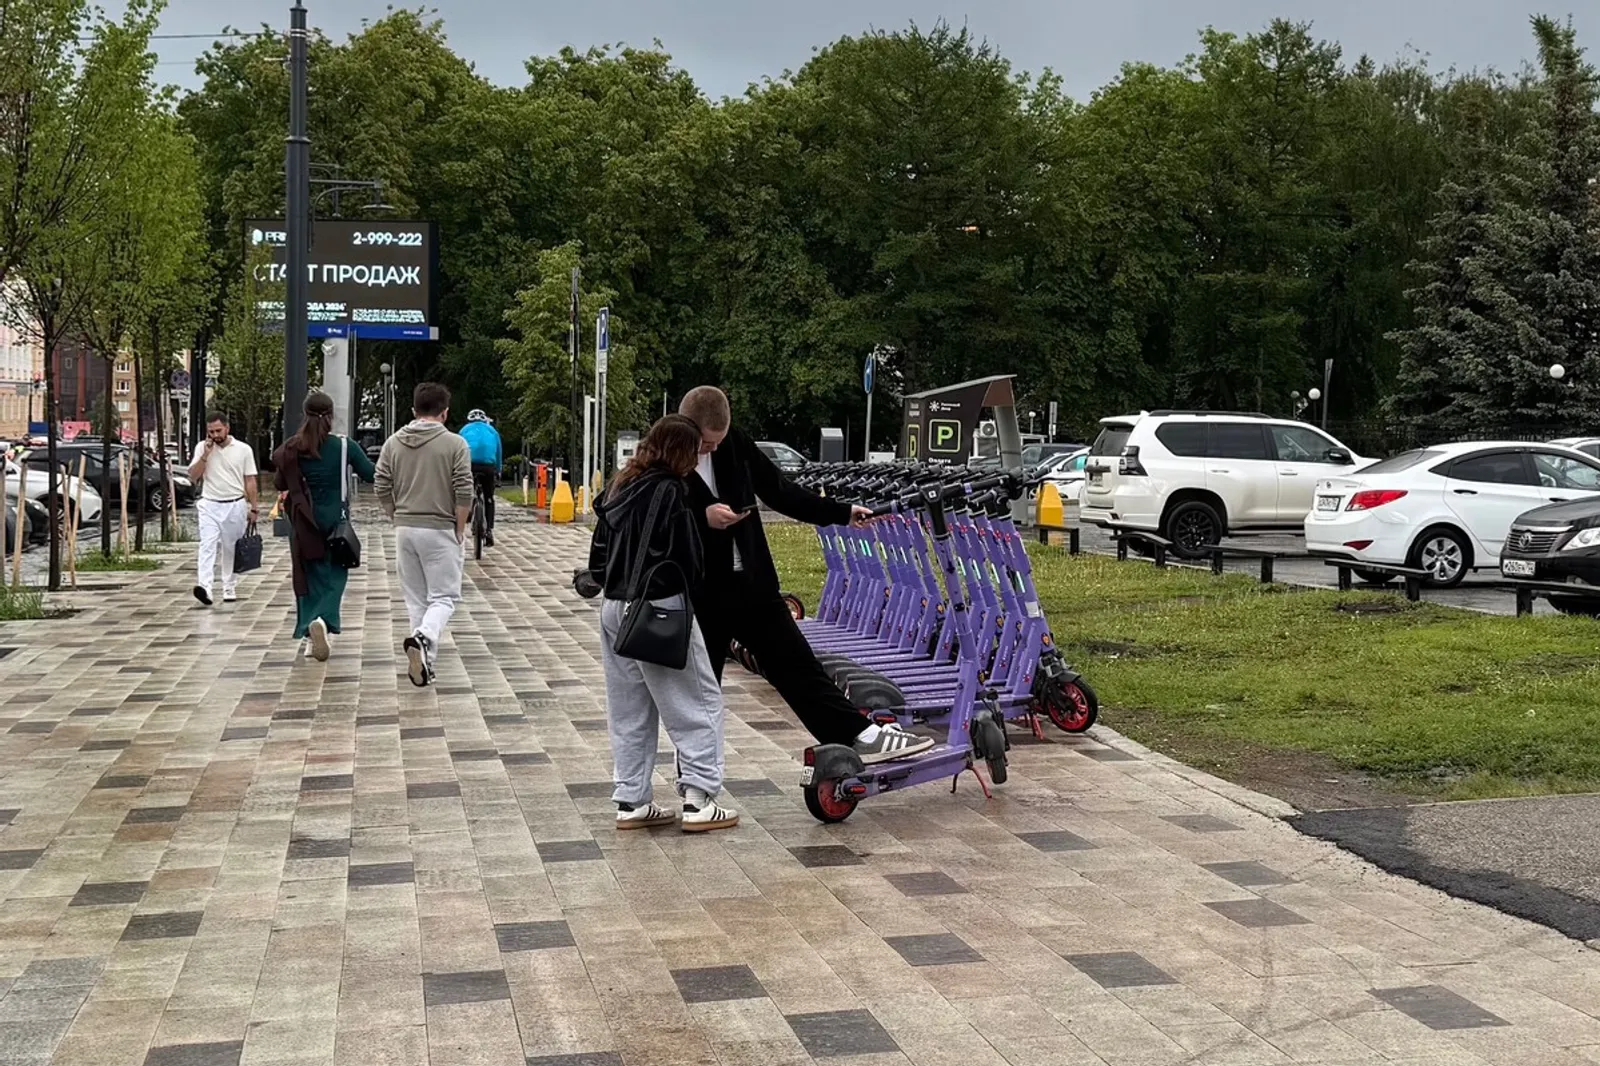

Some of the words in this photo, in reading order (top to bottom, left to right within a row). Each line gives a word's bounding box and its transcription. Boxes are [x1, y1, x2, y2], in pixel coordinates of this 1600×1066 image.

[353, 232, 422, 246] 2-999-222
[323, 265, 421, 287] ПРОДАЖ
[937, 426, 954, 446] P
